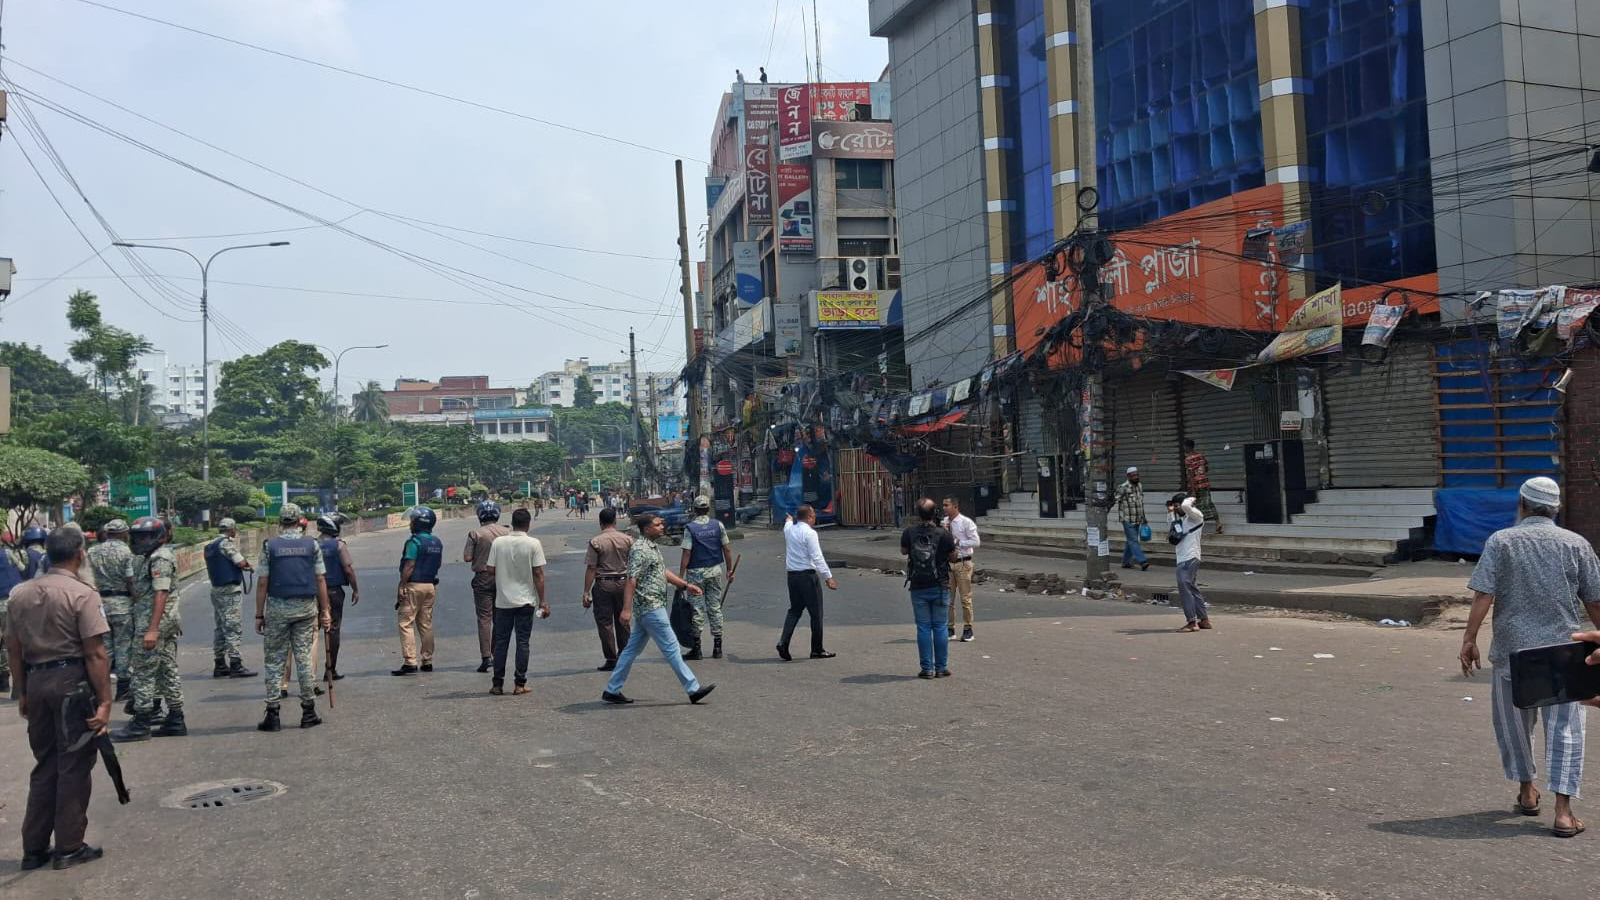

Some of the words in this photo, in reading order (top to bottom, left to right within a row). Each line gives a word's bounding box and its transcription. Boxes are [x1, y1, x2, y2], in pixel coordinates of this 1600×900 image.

[747, 148, 769, 211] রেটিনা
[1140, 237, 1201, 294] প্লাজা
[1248, 209, 1279, 320] Xiaoi
